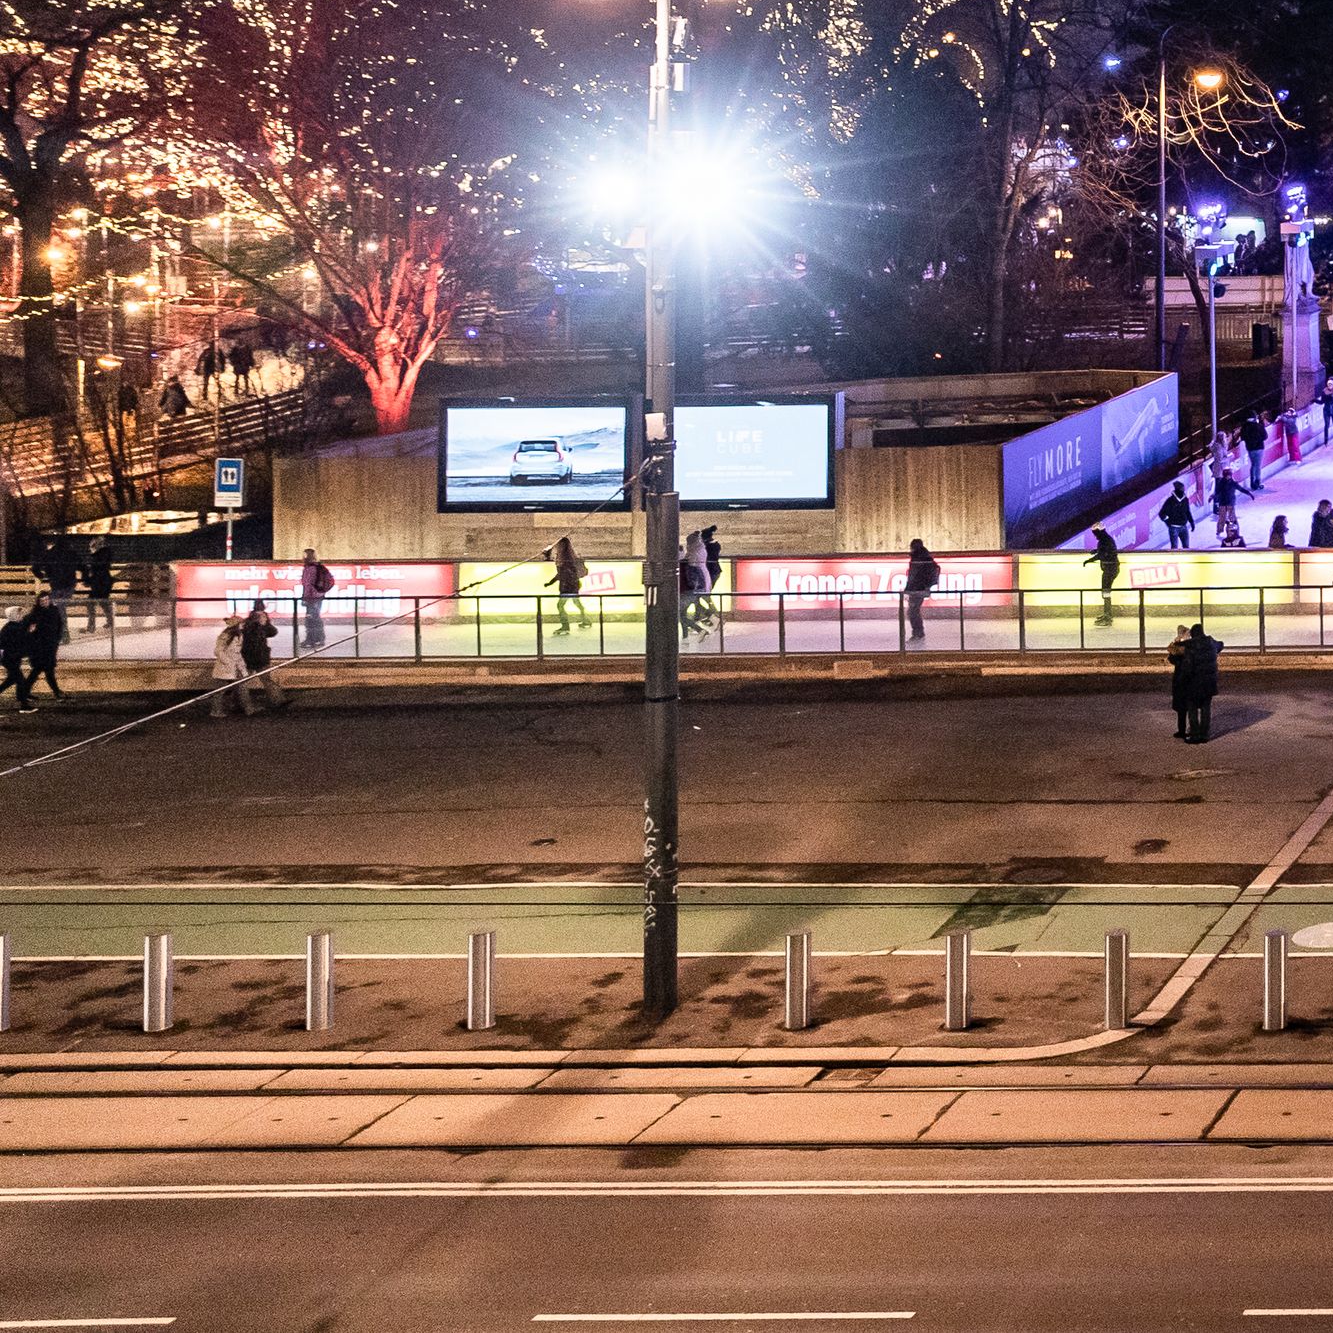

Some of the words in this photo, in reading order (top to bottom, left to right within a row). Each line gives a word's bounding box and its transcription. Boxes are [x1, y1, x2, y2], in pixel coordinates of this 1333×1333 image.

[224, 567, 269, 580] mehr
[272, 568, 303, 580] wie
[355, 566, 405, 580] leben.
[1132, 567, 1178, 586] BILLA
[769, 568, 871, 603] Kronen
[876, 569, 983, 605] Zeung
